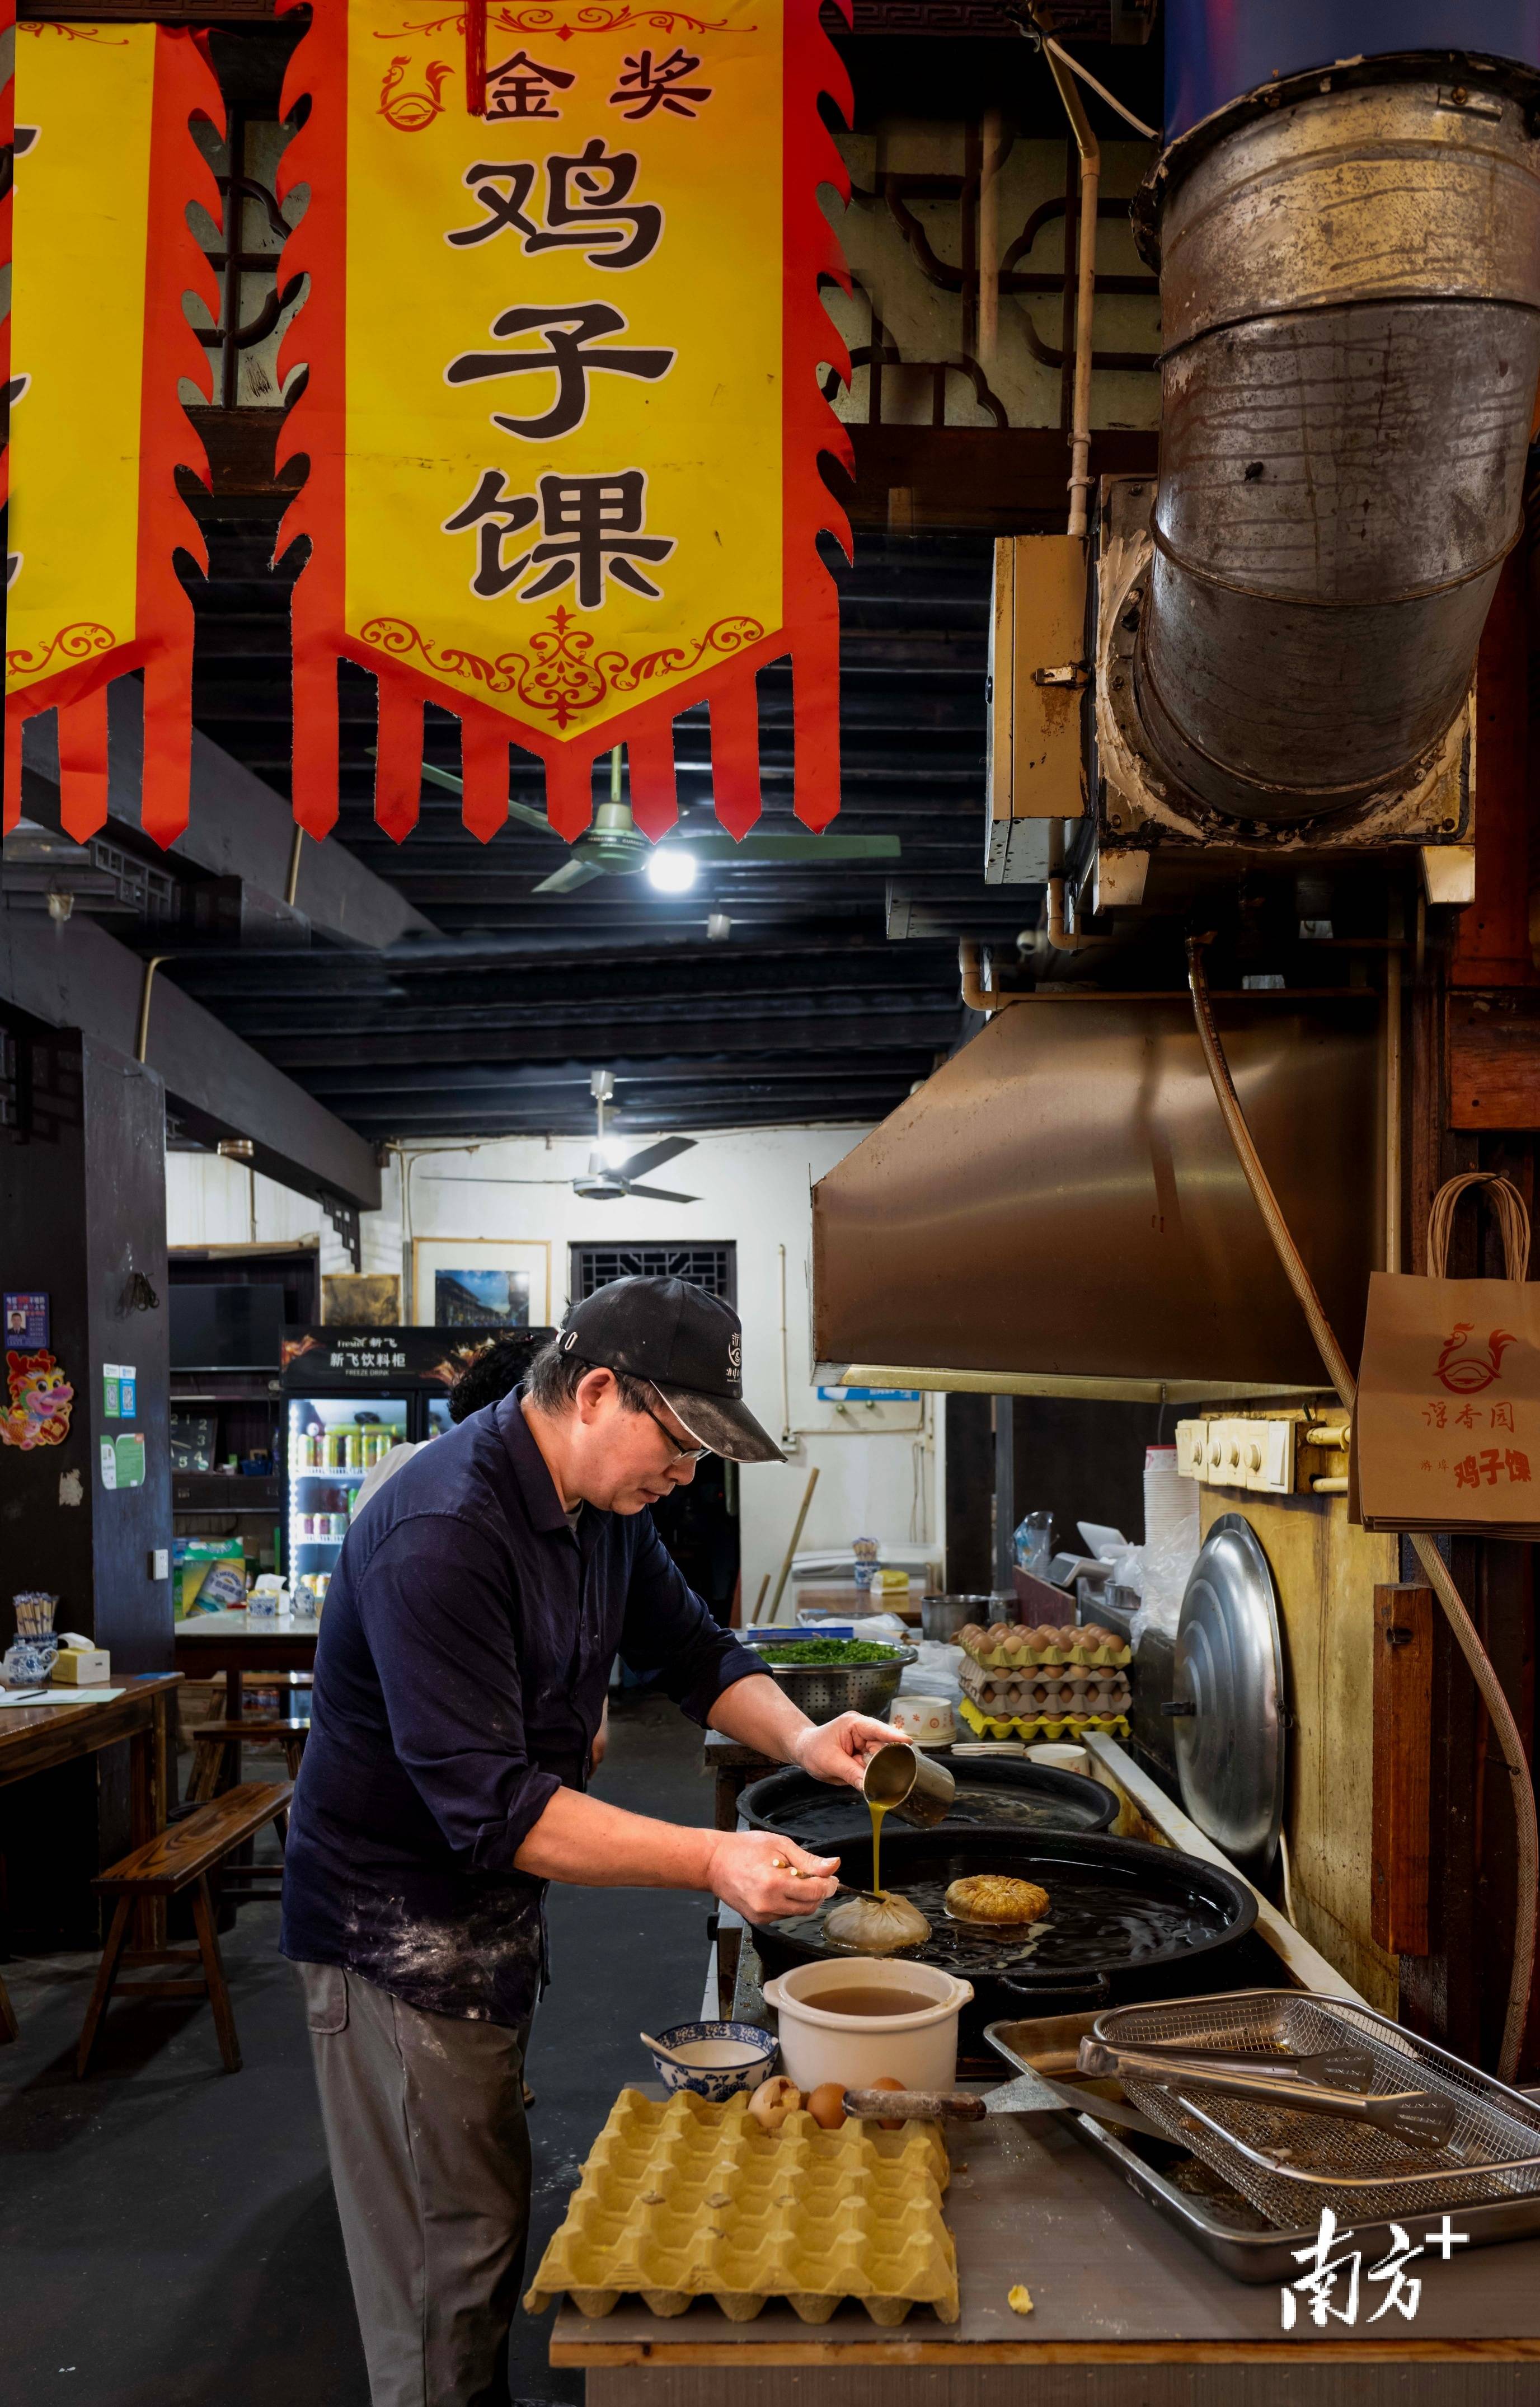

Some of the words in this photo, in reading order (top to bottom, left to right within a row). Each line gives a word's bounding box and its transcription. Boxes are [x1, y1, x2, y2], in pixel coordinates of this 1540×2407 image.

[486, 49, 712, 121] 金奖
[445, 138, 674, 607] 鸡子馃
[369, 1337, 398, 1348] 新飞
[330, 1352, 406, 1367] 新飞饮料柜
[1421, 1401, 1514, 1433] 浮香园
[199, 1418, 207, 1431] 2
[197, 1435, 205, 1446] 3
[179, 1456, 188, 1468] 5
[194, 1451, 203, 1461] 4
[1454, 1449, 1532, 1488] 鸡子馃
